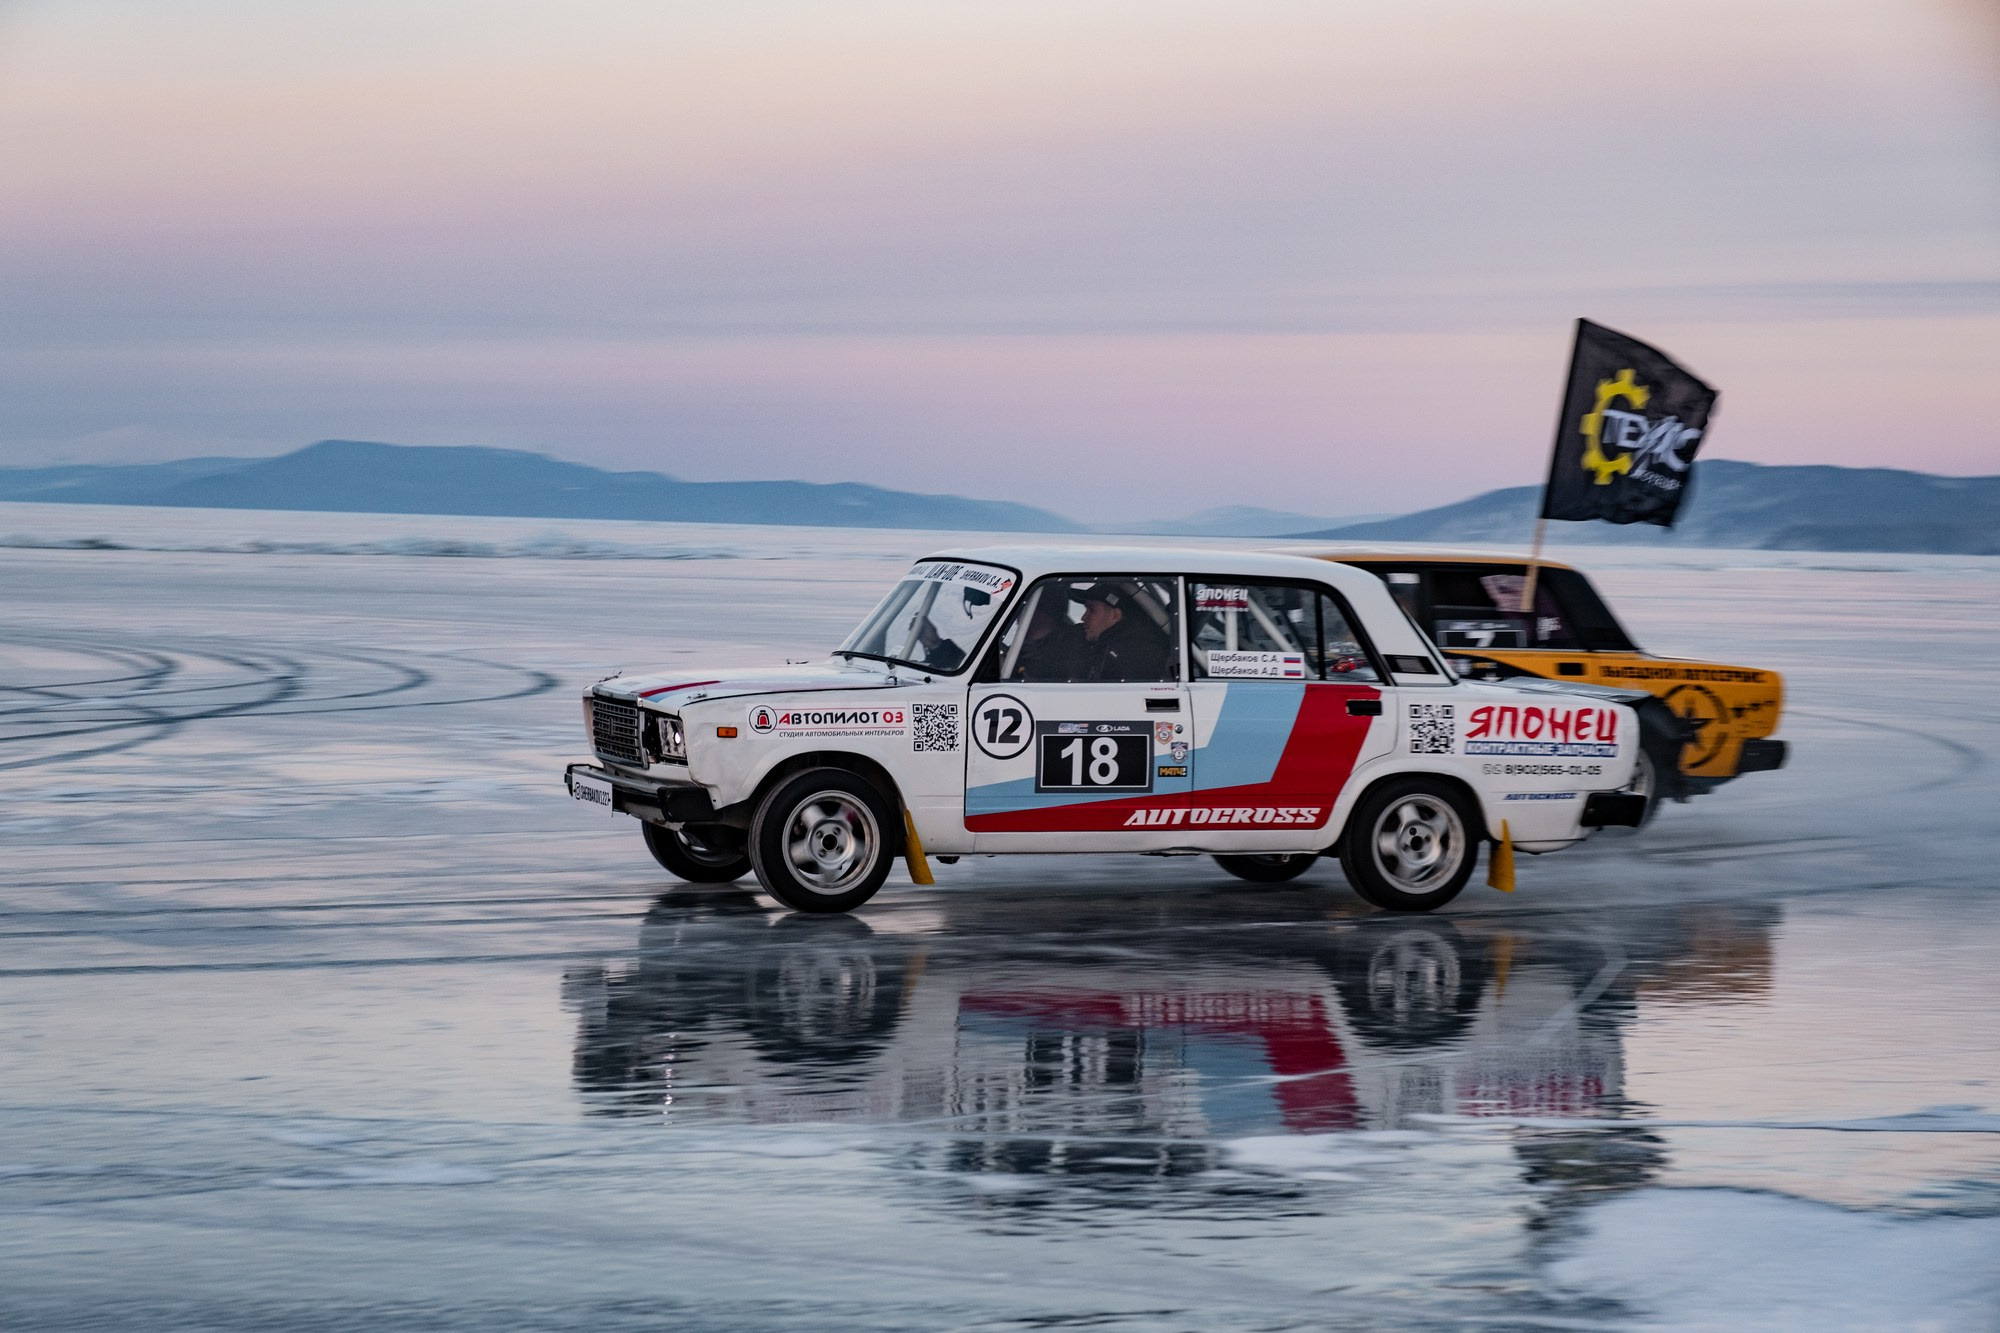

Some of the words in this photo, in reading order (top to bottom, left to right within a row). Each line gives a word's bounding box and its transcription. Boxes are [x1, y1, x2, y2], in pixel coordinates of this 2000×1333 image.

[1195, 588, 1249, 601] ЯПОНЕЦ
[1210, 652, 1258, 663] Щербаков
[1210, 665, 1258, 676] Щербаков
[779, 711, 879, 725] АВТОПИЛОТ
[983, 708, 1022, 743] 12
[1465, 705, 1618, 744] ЯПОНЕЦ
[805, 730, 863, 738] АВТОМОБИЛЬНЫХ
[864, 729, 905, 737] ИНТЕРЬЕРОВ
[1466, 741, 1555, 756] КОНТРАКТНЫЕ
[1558, 744, 1618, 758] ЗАПЧАСТИ
[1061, 737, 1119, 785] 18
[1123, 807, 1322, 826] AUTOCROSS
